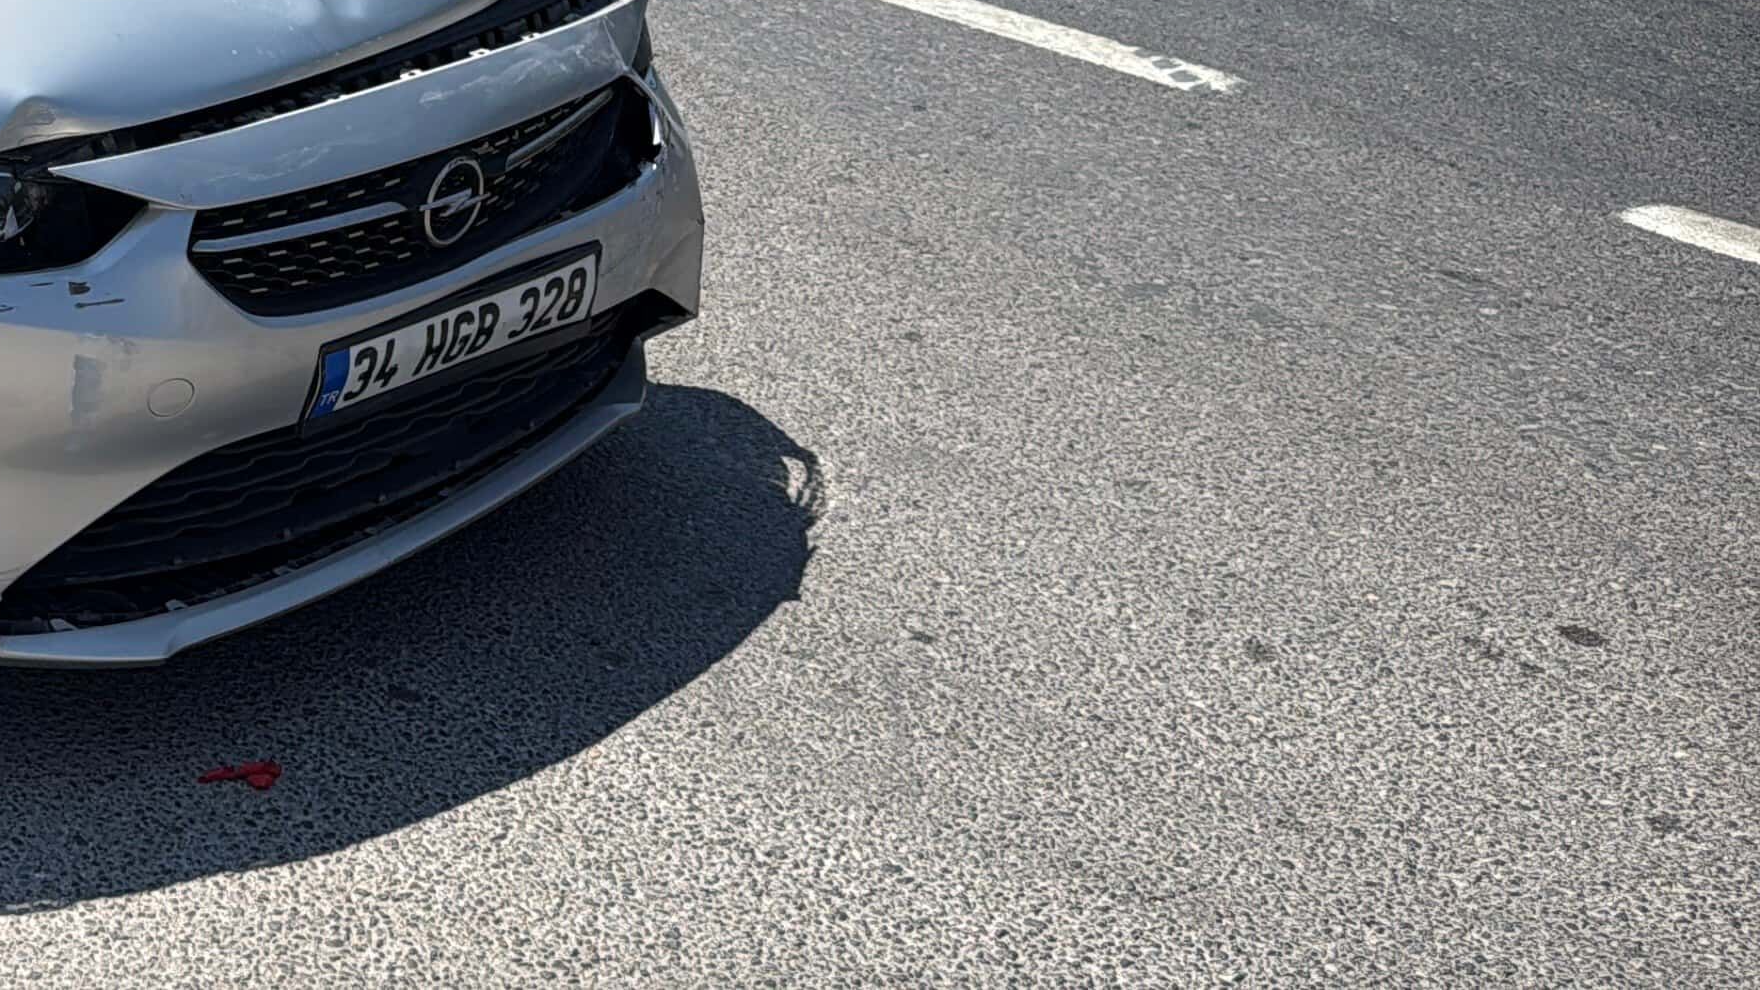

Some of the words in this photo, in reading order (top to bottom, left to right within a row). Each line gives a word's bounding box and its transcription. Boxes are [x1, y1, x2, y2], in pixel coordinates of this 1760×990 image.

[343, 338, 398, 401] 34
[412, 302, 501, 377] HGB
[508, 267, 587, 339] 328
[320, 390, 340, 407] TR
